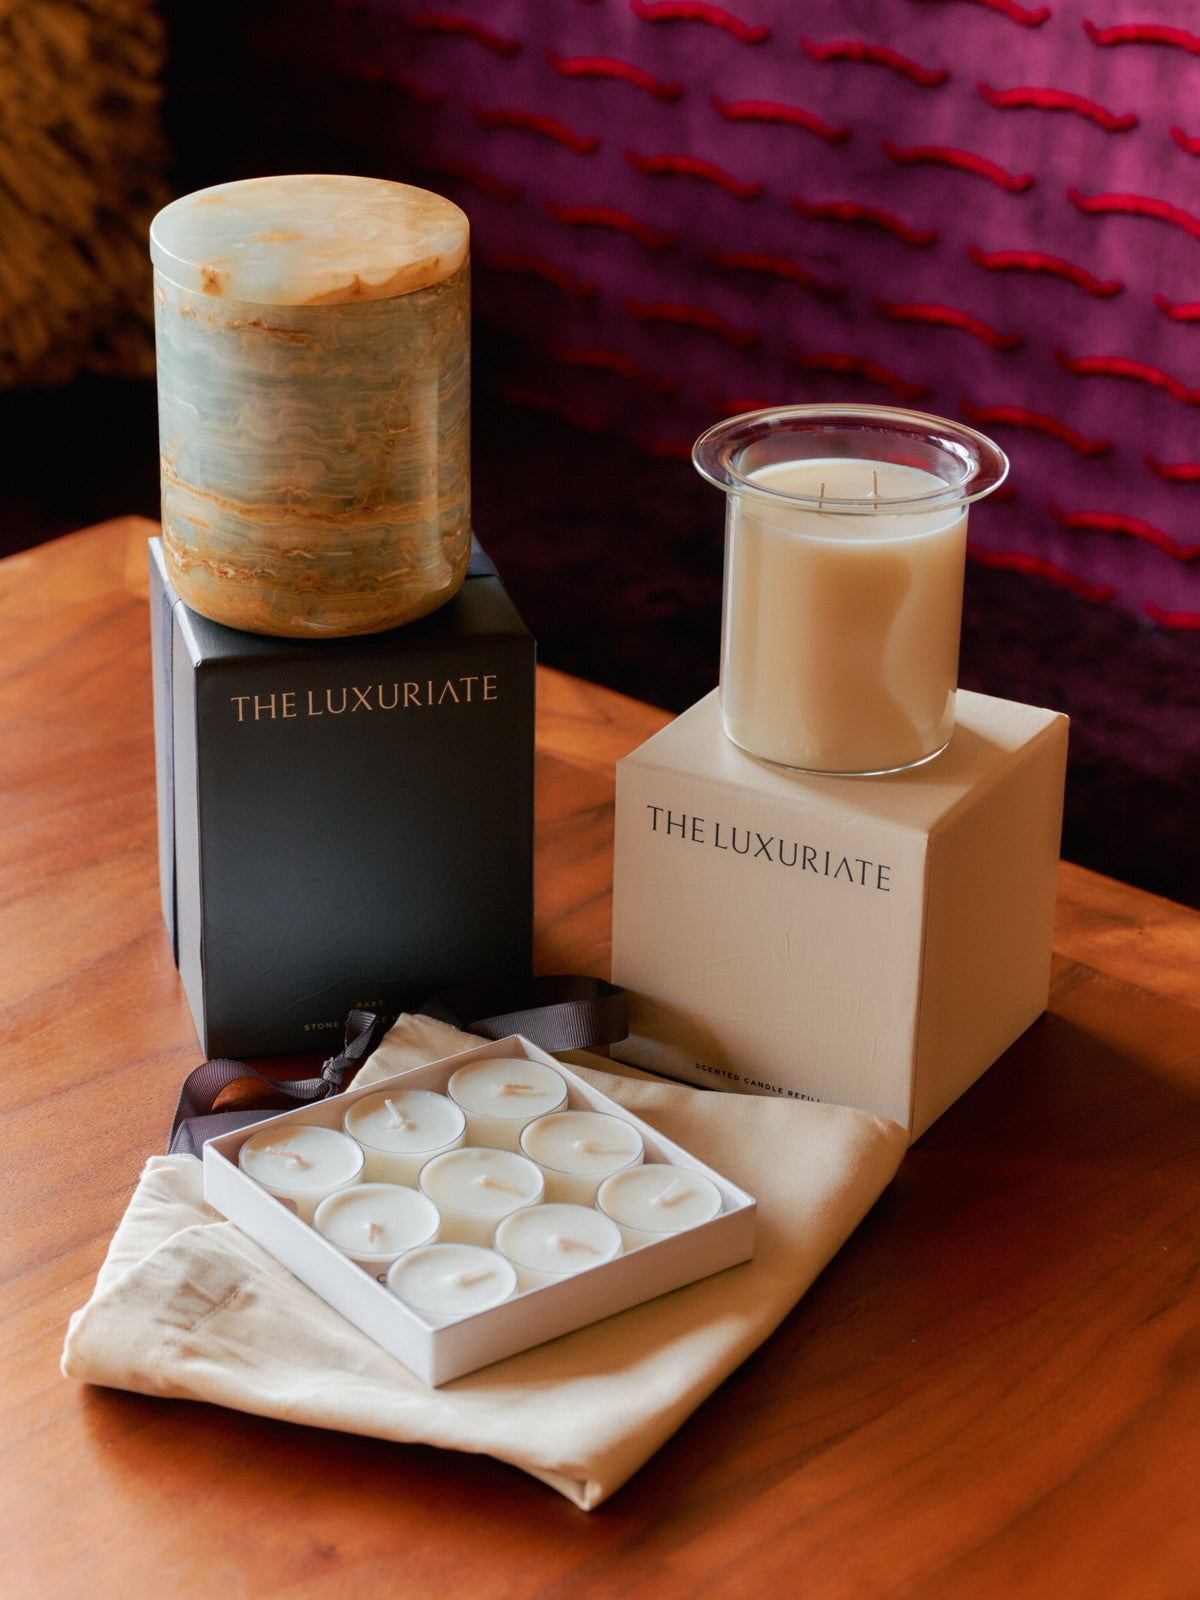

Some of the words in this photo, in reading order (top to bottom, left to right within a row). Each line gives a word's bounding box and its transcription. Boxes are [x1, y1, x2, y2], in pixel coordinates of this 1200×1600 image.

[231, 692, 297, 722] THE
[307, 674, 498, 716] LUXURIATE
[647, 805, 705, 844] THE
[714, 822, 892, 892] LUXURIATE
[304, 1021, 339, 1031] STONE
[695, 1063, 740, 1081] SCENTED
[743, 1077, 783, 1094] CANDLE
